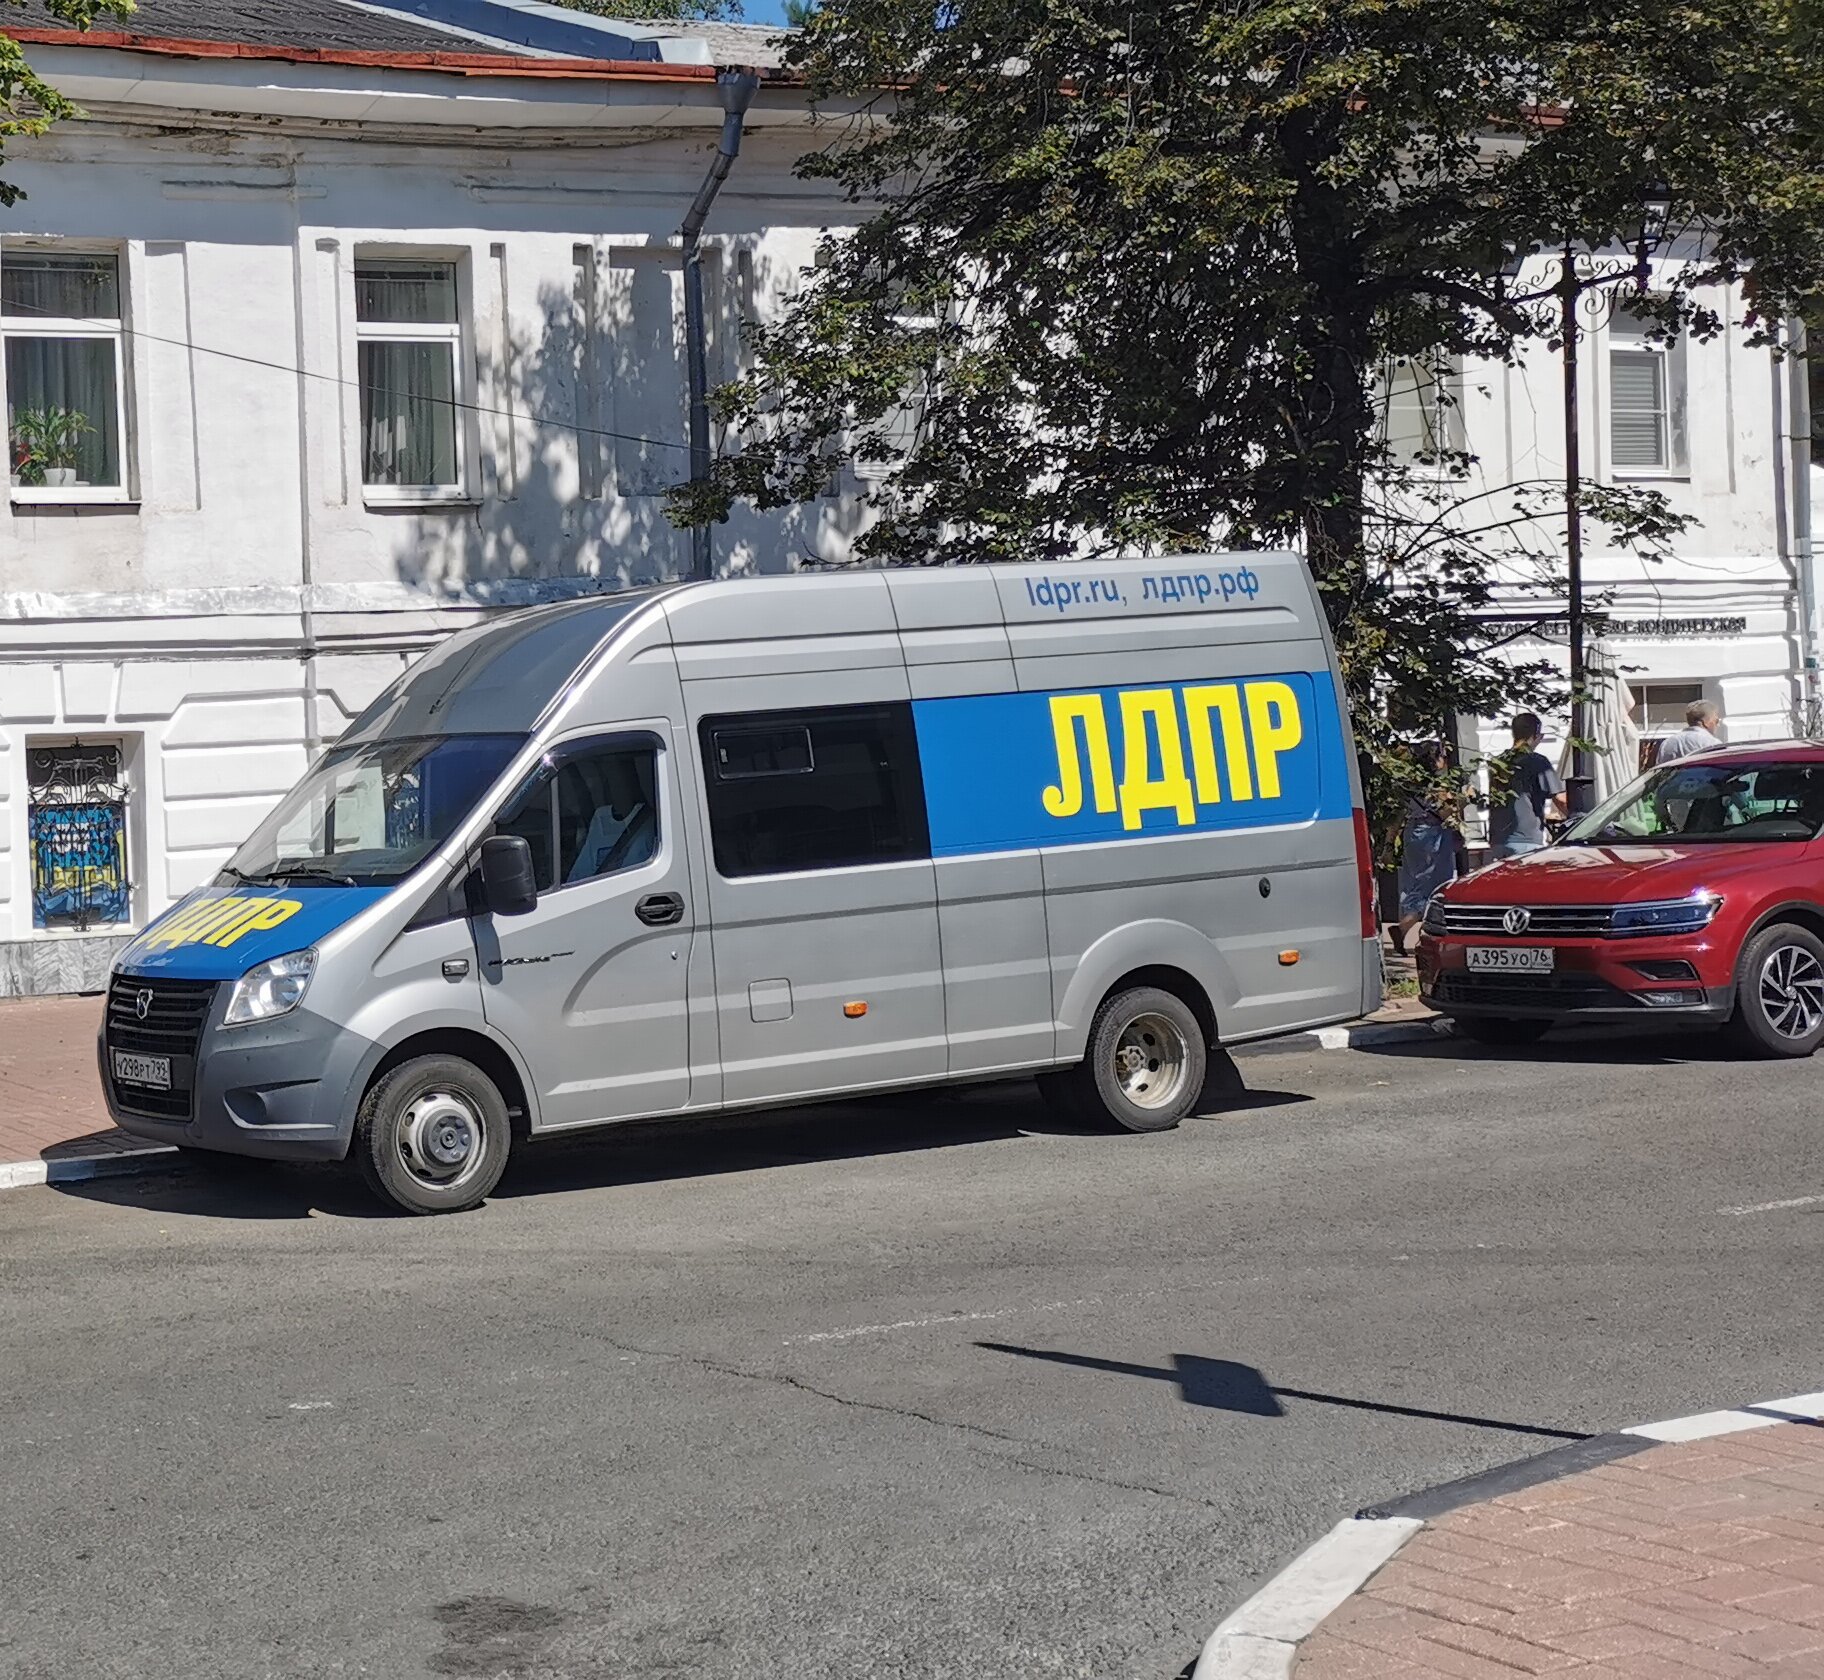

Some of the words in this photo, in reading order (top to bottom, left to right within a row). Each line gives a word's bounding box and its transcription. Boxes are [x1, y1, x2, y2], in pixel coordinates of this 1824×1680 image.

[1025, 576, 1128, 612] ldpr.ru,
[1142, 566, 1259, 603] лдпр.рф
[1042, 681, 1302, 831] ЛДПР
